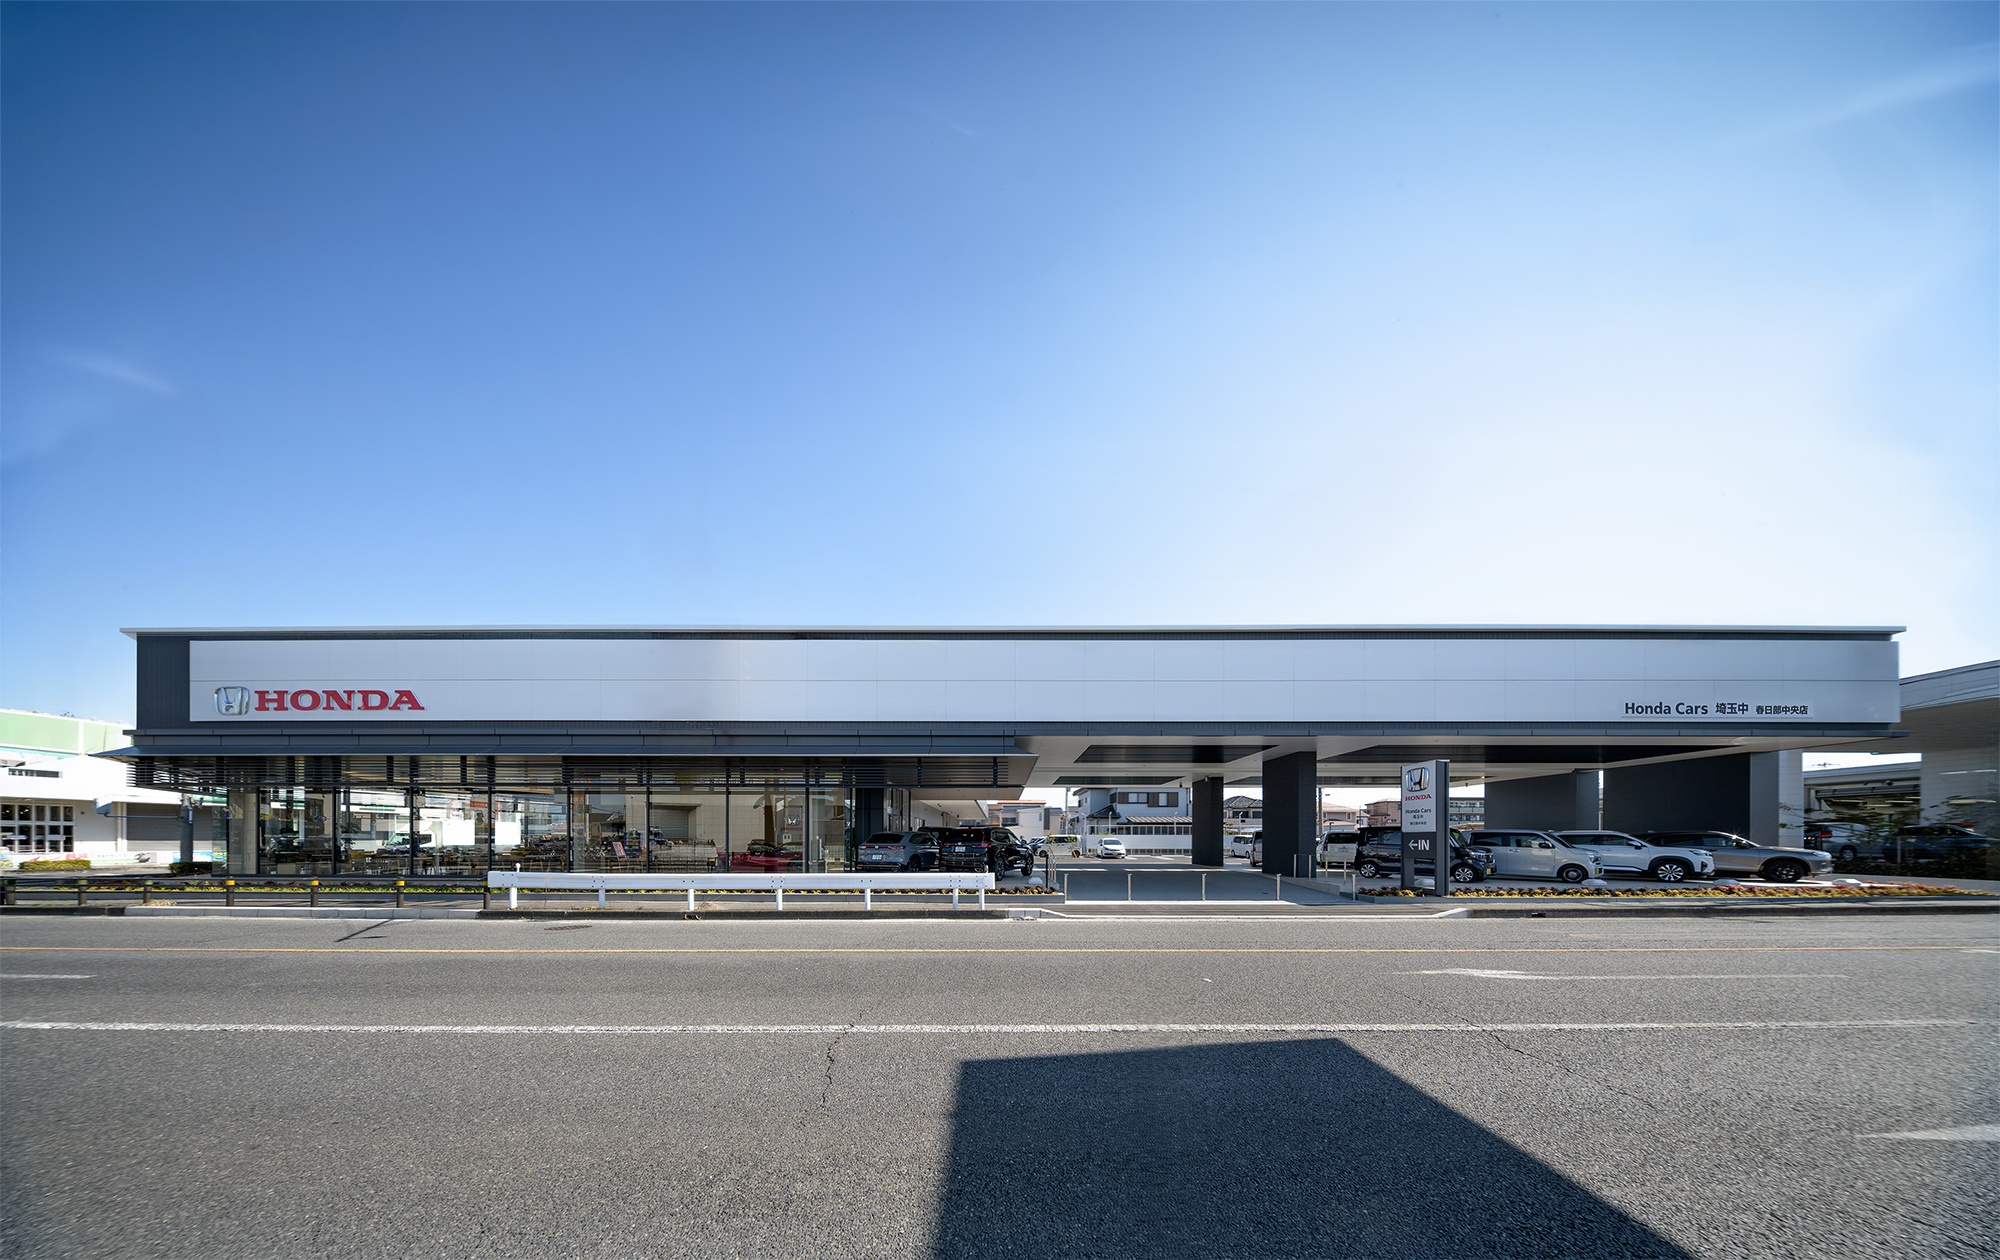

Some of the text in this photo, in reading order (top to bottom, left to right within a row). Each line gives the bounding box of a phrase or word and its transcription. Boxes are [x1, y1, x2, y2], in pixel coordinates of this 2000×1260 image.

[254, 689, 425, 711] HONDA
[1625, 702, 1809, 715] Honda Cars 埼玉中 春日部中央店
[1418, 840, 1430, 850] IN
